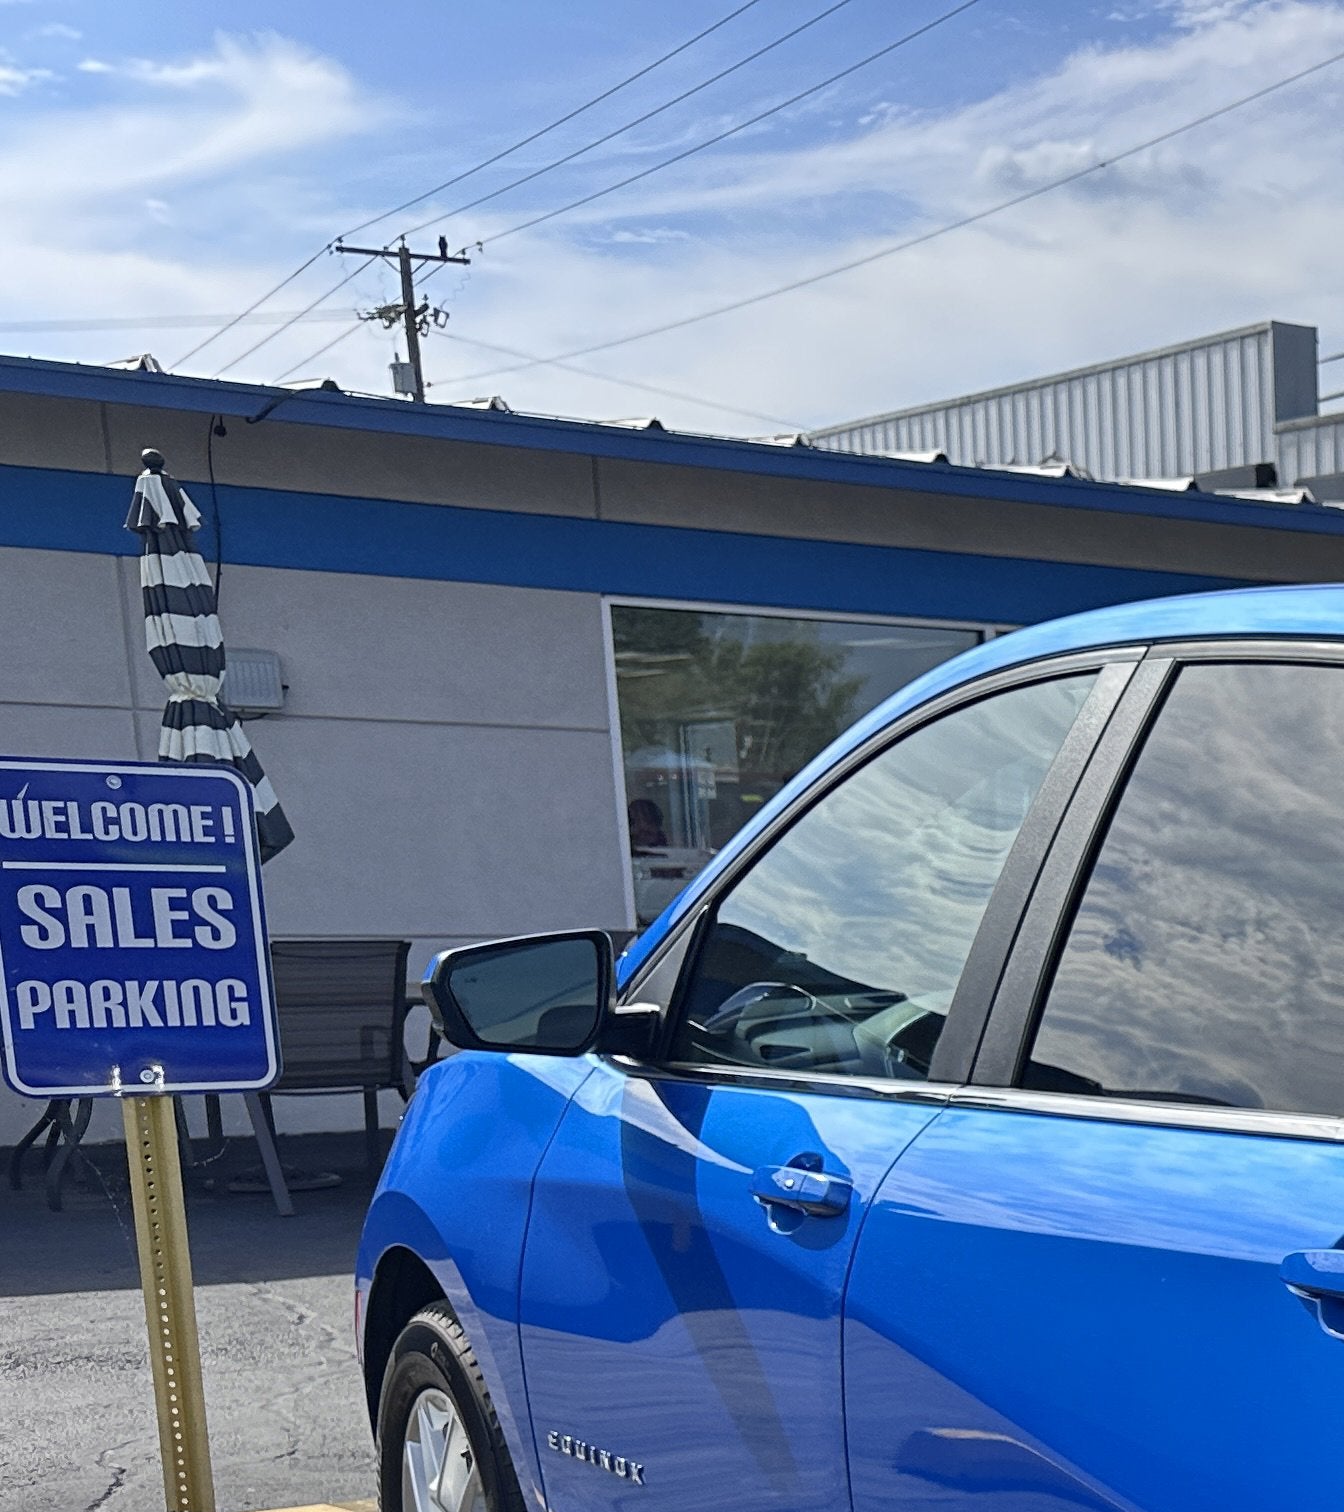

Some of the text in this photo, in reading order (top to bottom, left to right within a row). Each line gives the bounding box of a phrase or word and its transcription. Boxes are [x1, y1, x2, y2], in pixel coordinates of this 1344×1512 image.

[17, 884, 237, 950] SALES
[16, 978, 250, 1030] PARKING
[547, 1430, 646, 1486] EQUINOX
